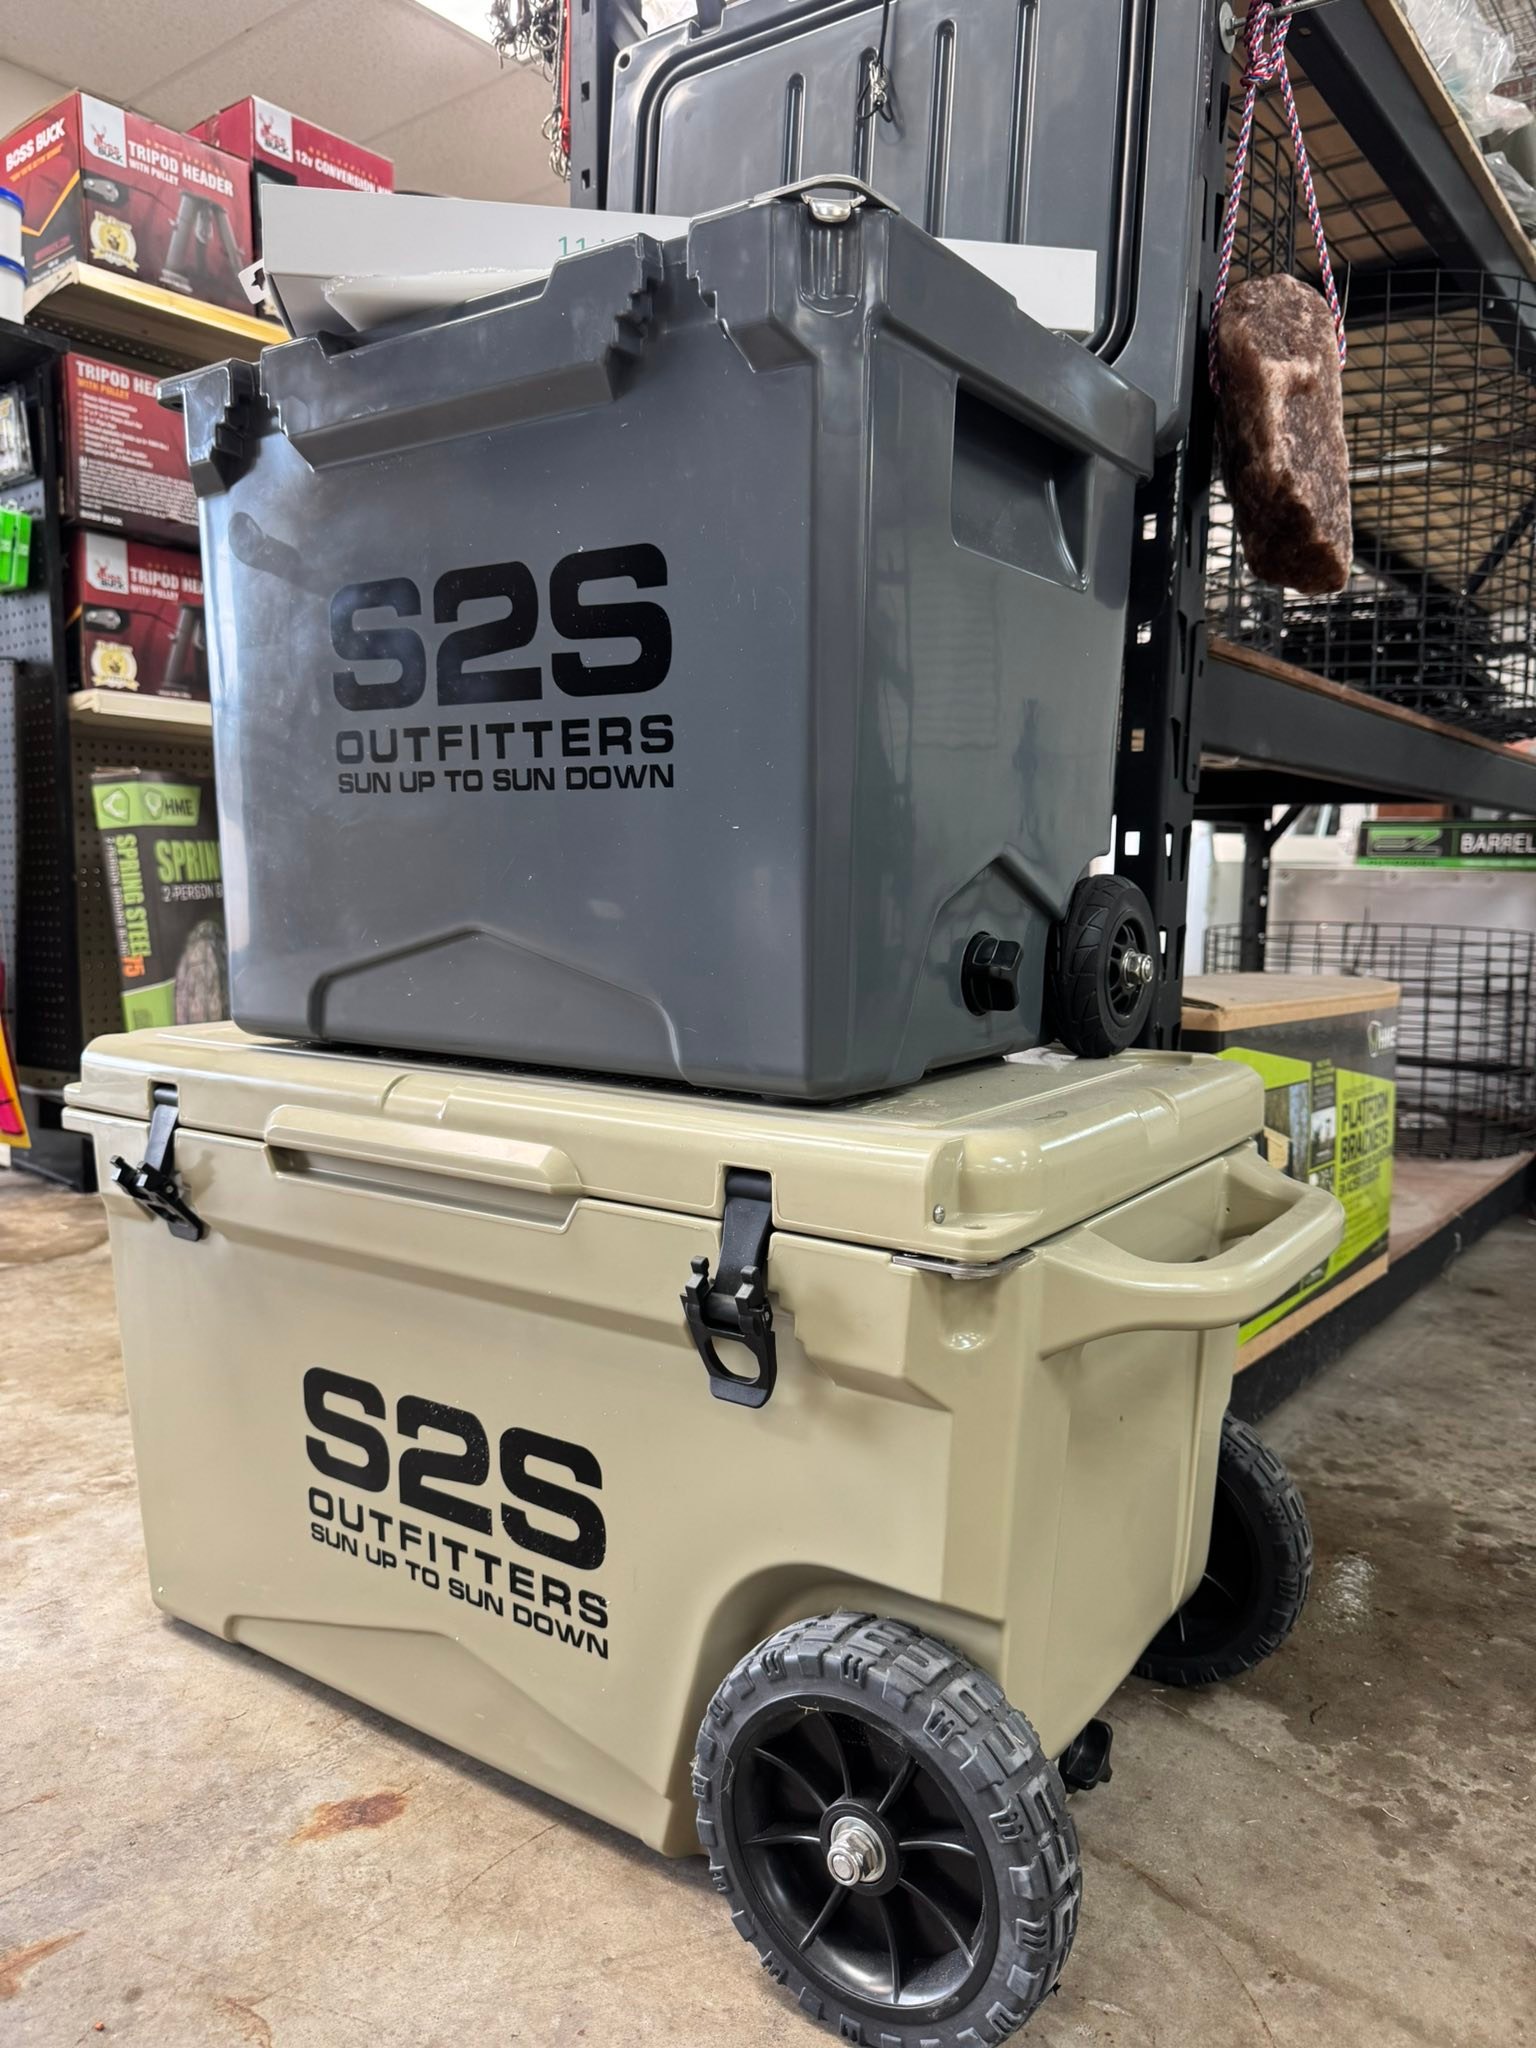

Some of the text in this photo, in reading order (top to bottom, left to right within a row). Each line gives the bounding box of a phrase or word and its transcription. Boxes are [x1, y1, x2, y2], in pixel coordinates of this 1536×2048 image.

[6, 138, 35, 173] BOSS
[36, 117, 66, 152] BUCK
[128, 140, 179, 174] TRIPOD
[182, 161, 234, 197] HEADER
[129, 158, 150, 175] WITH
[76, 360, 130, 390] TRIPOD
[130, 565, 180, 591] TRIPOD
[329, 542, 673, 712] S2S
[335, 713, 675, 764] OUTFITTERS
[338, 763, 675, 794] SUN UP TO SUN DOWN
[164, 798, 195, 817] HME
[115, 832, 145, 906] SPRING
[162, 883, 214, 903] 2-PERSON
[124, 905, 152, 957] STEEL
[303, 1366, 607, 1571] S2S
[308, 1486, 609, 1629] OUTFITTERS
[310, 1521, 609, 1660] SUN UP TO SUN DOWN
